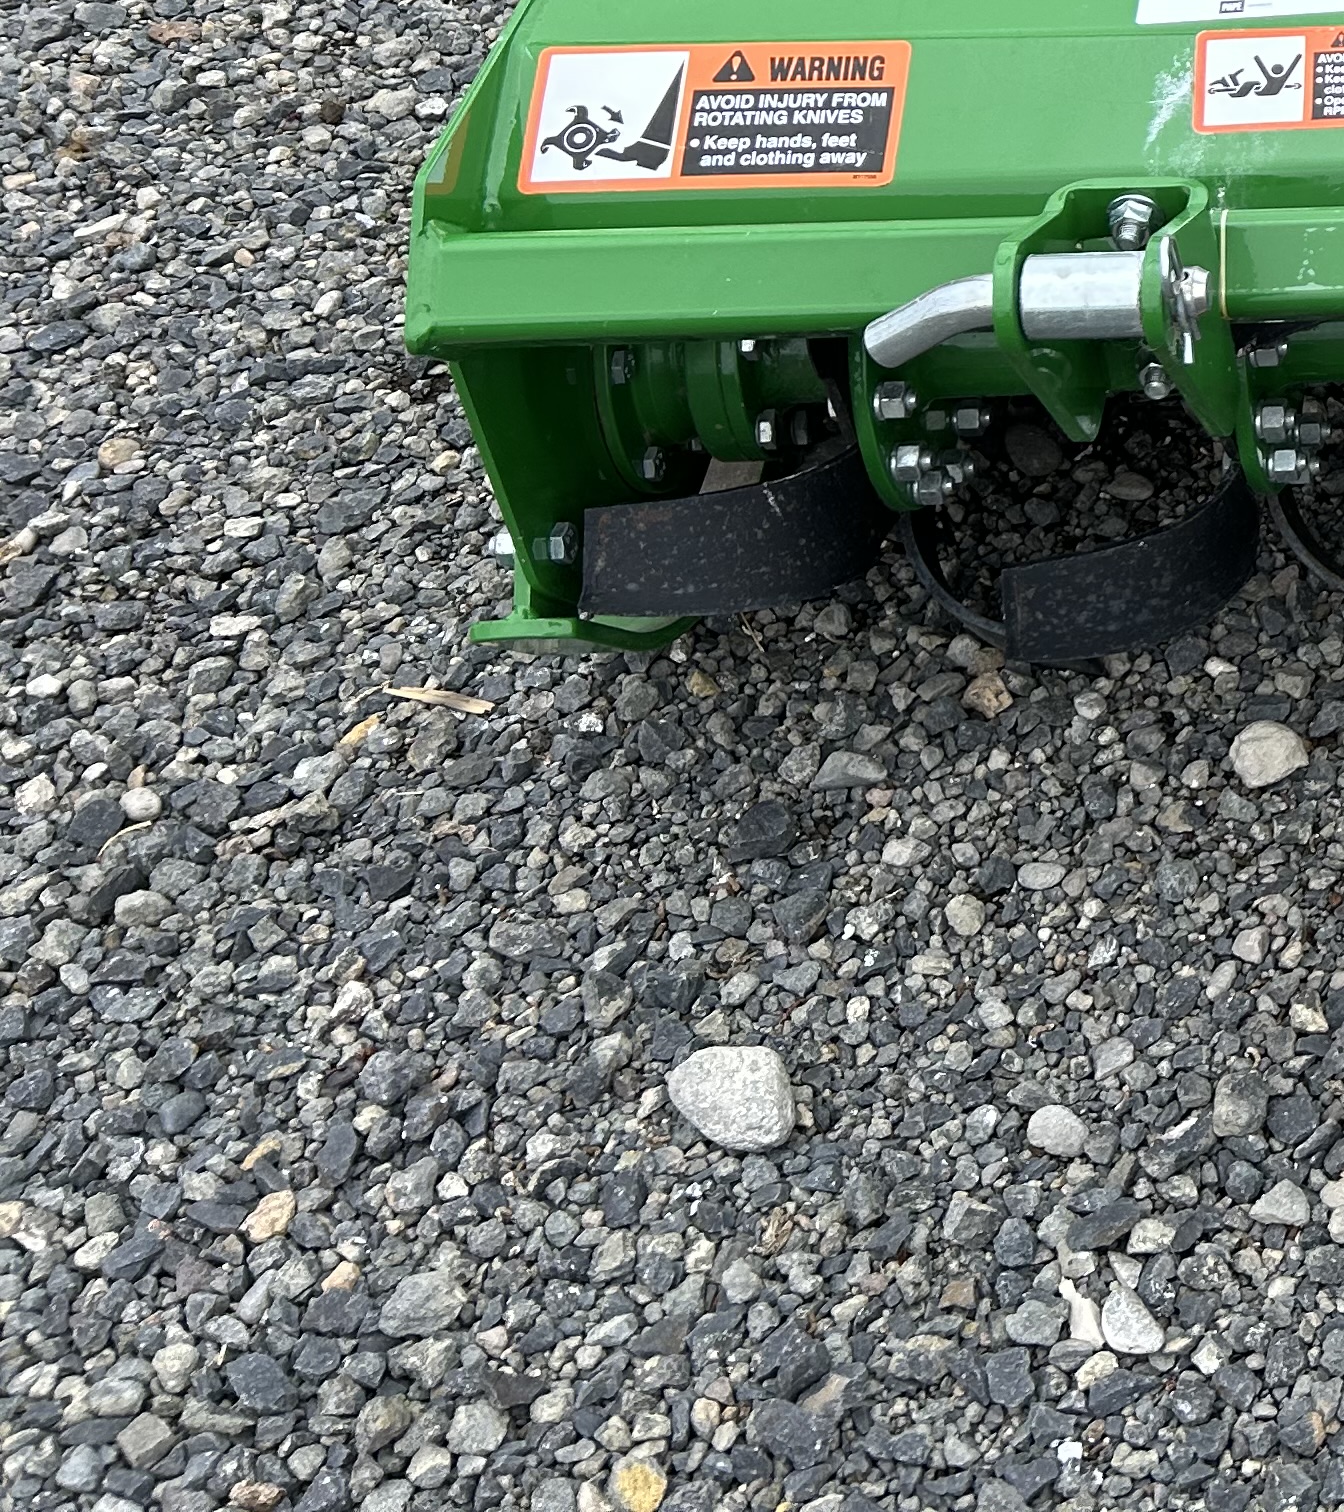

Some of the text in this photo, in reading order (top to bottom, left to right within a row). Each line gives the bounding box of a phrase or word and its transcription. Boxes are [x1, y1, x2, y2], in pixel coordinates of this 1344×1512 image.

[769, 55, 885, 82] WARNING
[696, 92, 888, 110] AVOID INJURY FROM
[693, 108, 864, 127] ROTATING KNIVES
[703, 132, 857, 151] Keep hands, feet
[699, 150, 867, 169] and clothing away
